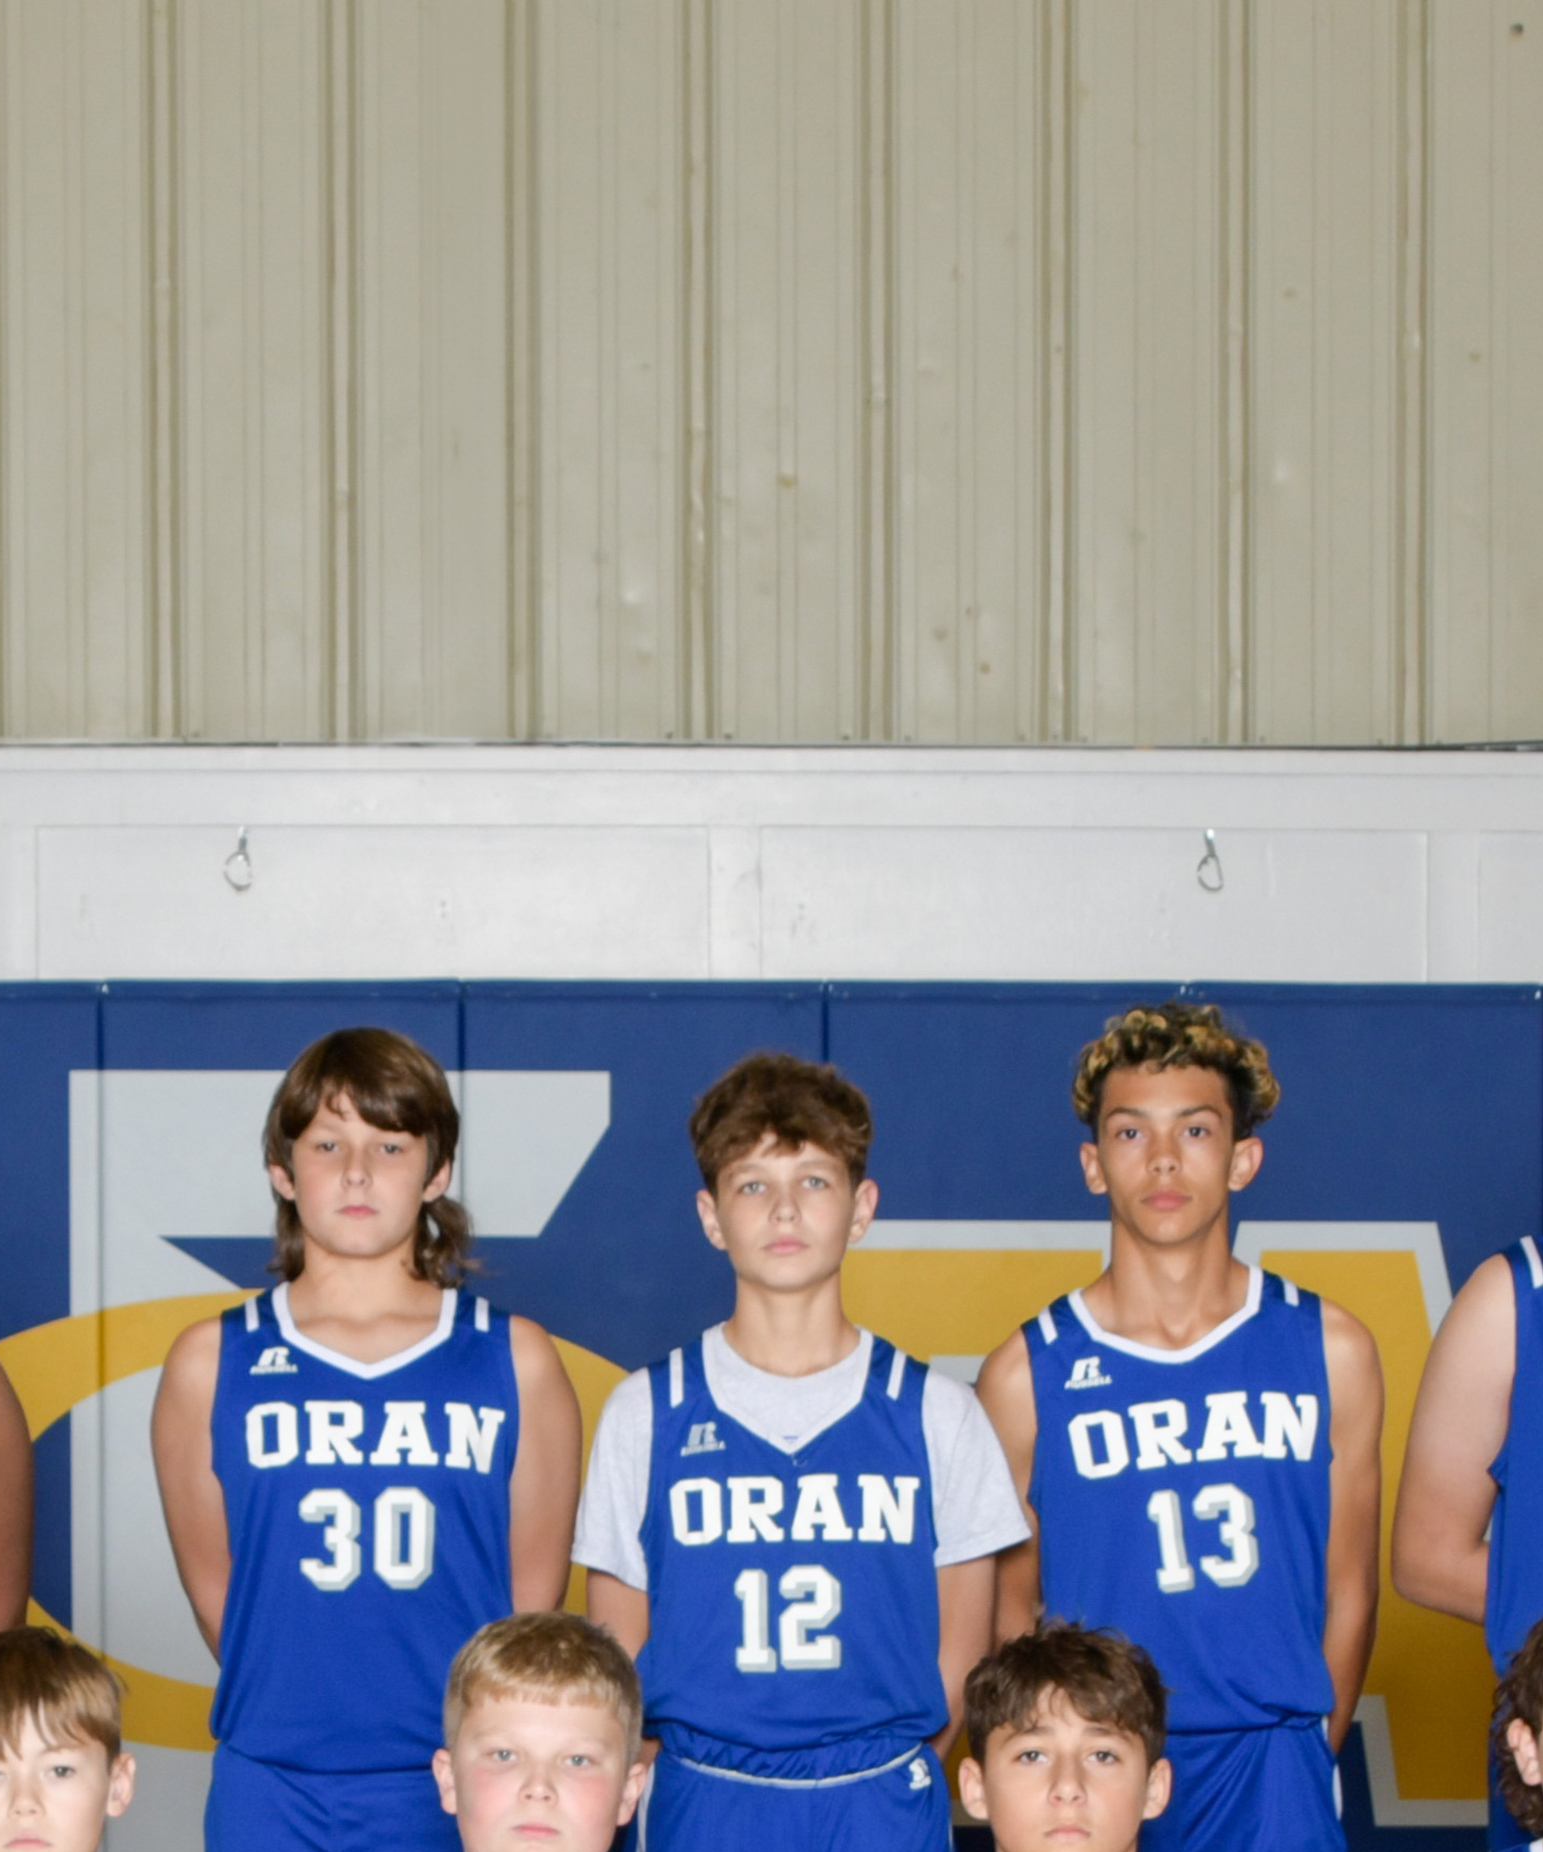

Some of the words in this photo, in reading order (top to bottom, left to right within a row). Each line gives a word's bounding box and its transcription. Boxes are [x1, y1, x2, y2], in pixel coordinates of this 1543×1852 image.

[245, 1399, 506, 1475] ORAN
[1067, 1390, 1319, 1480] ORAN
[298, 1486, 436, 1592] 30
[669, 1472, 921, 1547] ORAN
[1146, 1482, 1260, 1594] 13
[733, 1564, 842, 1673] 12
